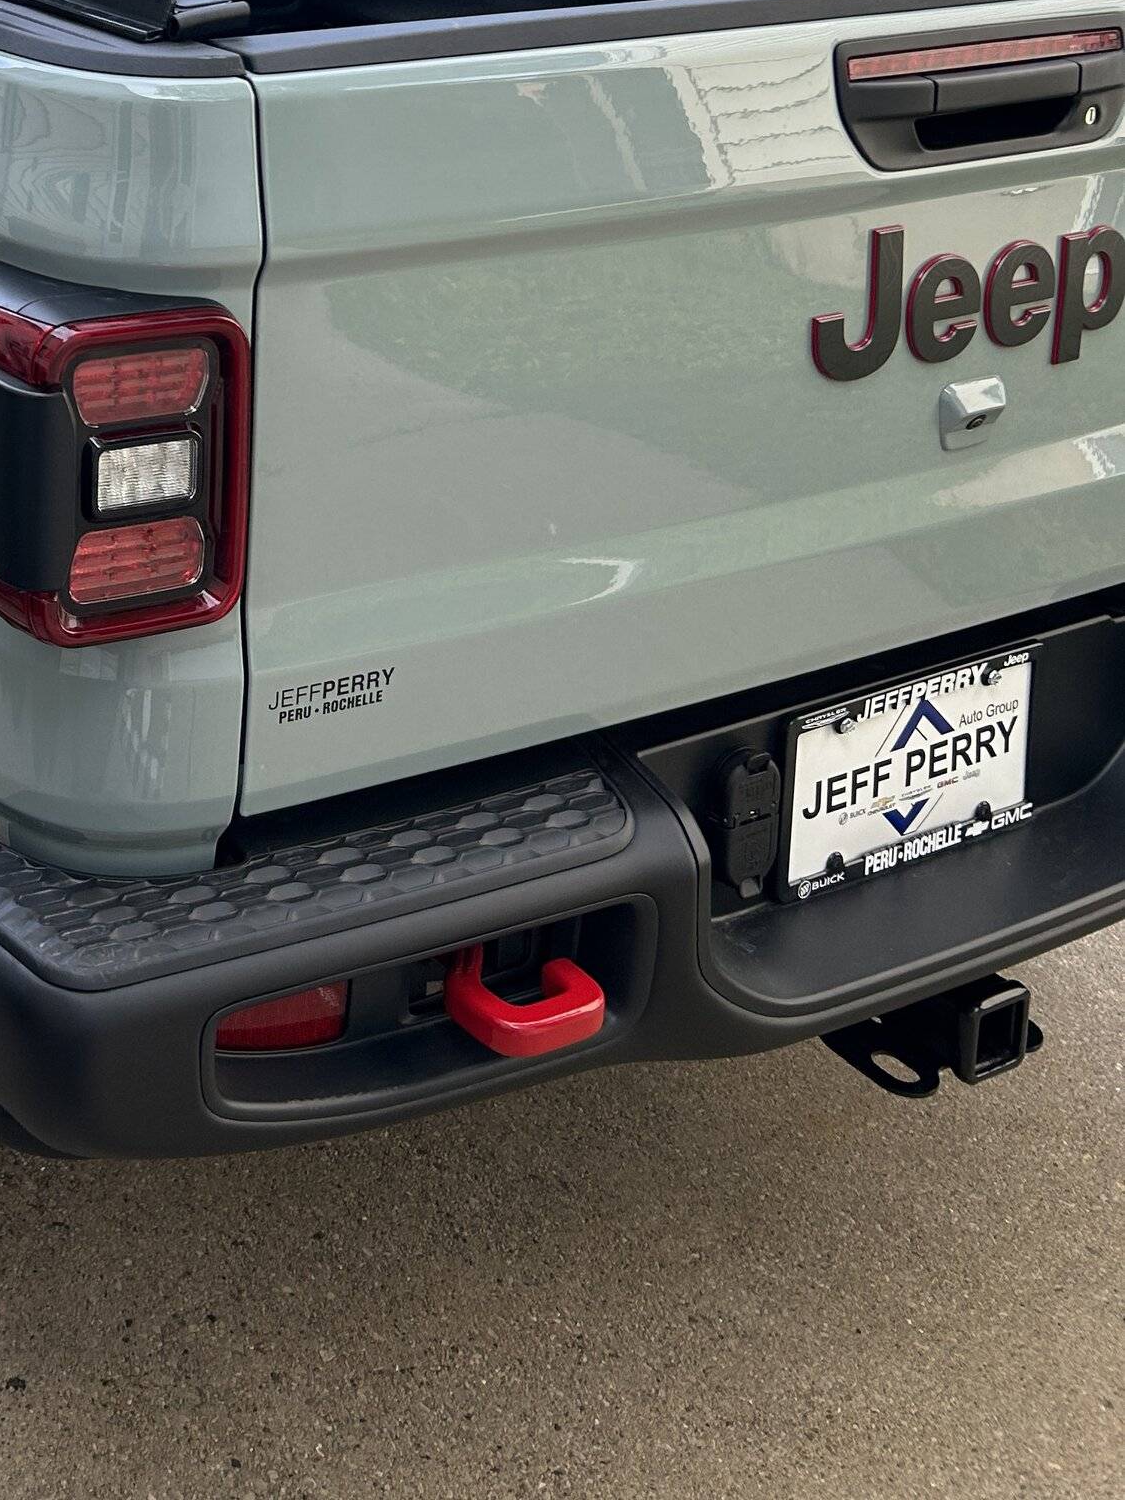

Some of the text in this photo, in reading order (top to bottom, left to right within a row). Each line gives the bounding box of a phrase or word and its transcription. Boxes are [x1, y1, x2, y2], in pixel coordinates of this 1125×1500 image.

[811, 224, 1125, 382] Jeep
[1003, 652, 1030, 667] Jeep
[278, 690, 383, 724] PERU ROCHELLE
[958, 698, 1019, 728] Auto Group
[801, 715, 1019, 820] JEFF PERRY
[936, 776, 959, 789] GMC
[991, 802, 1033, 831] GMC
[811, 871, 846, 892] BUICK
